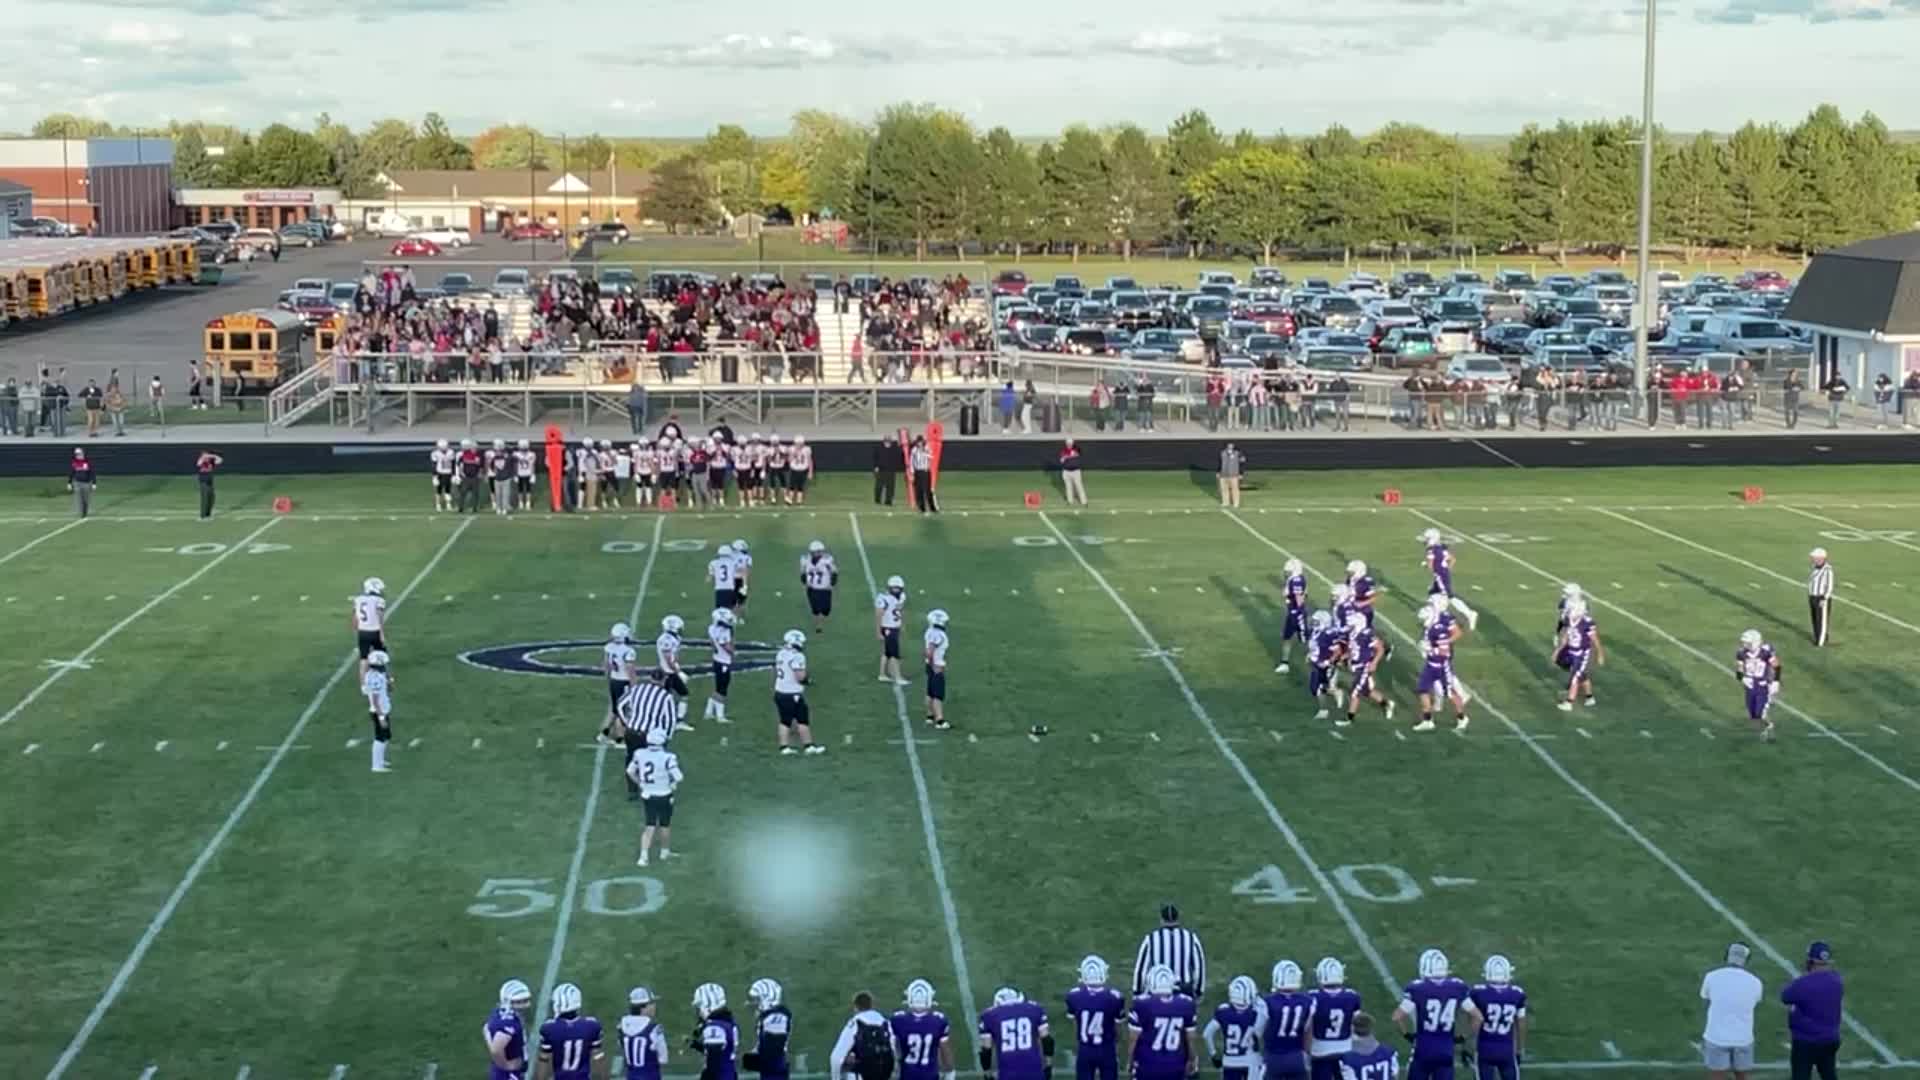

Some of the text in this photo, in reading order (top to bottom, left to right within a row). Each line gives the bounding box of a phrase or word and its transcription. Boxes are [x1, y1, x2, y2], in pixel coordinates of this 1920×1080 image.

[643, 761, 655, 784] 2
[466, 876, 668, 917] 50
[1231, 864, 1424, 903] 40
[1080, 1010, 1105, 1044] 14
[1277, 1005, 1303, 1037] 11
[1325, 1008, 1345, 1039] 3
[1423, 998, 1458, 1032] 34
[1482, 1003, 1517, 1035] 33
[904, 1033, 934, 1066] 31
[1000, 1016, 1032, 1052] 58
[1151, 1016, 1185, 1051] 76
[622, 1036, 648, 1067] 10
